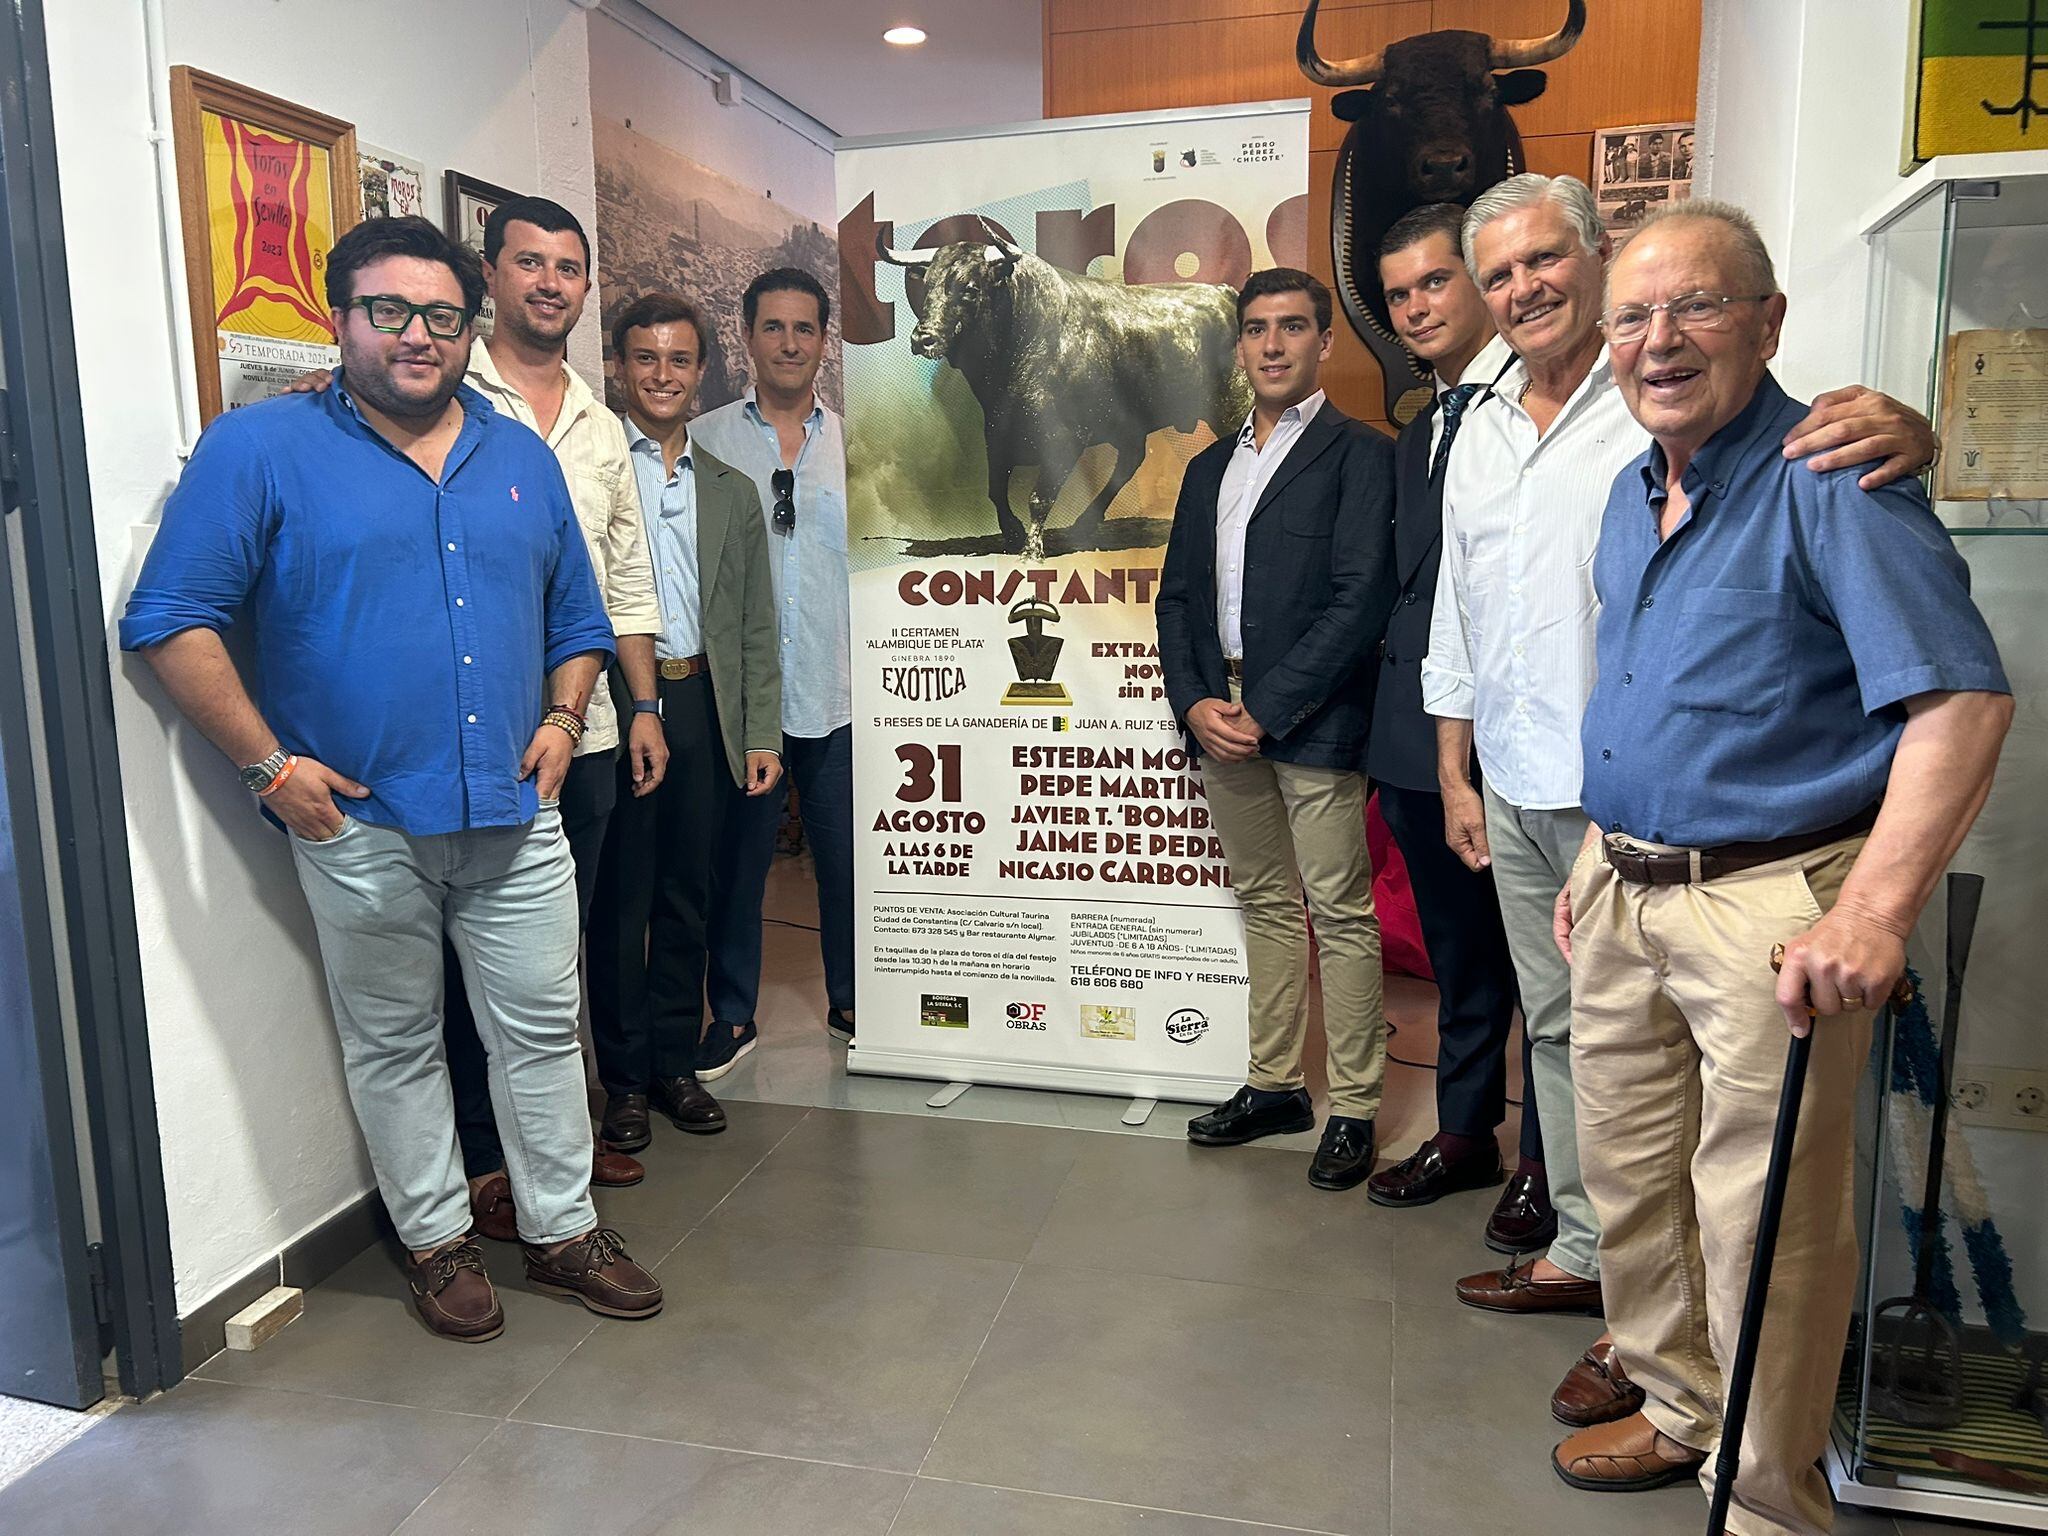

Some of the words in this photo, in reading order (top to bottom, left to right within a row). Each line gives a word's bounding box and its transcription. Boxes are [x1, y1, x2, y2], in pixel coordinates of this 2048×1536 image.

[1242, 141, 1275, 149] PEDRO
[1243, 147, 1274, 155] PÉREZ
[247, 140, 288, 178] Toros
[264, 183, 277, 196] en
[254, 197, 289, 227] Sevilla
[262, 241, 282, 256] 2023
[837, 191, 1308, 345] tro
[245, 344, 305, 363] TEMPORADA
[308, 353, 326, 364] 2023
[240, 363, 262, 371] JUEVES
[243, 375, 276, 383] NOVILLADA
[898, 569, 1164, 606] CONSTANT
[901, 628, 959, 637] CERTAMEN
[934, 639, 947, 649] DE
[1091, 643, 1159, 657] EXTRA
[891, 654, 932, 662] GINEBRA
[934, 654, 955, 662] 1890
[1124, 664, 1163, 679] NOV
[882, 665, 967, 702] EXÓTICA
[1118, 682, 1144, 698] sin
[874, 717, 881, 728] 5
[884, 718, 924, 728] RESES
[927, 718, 943, 728] DE
[945, 718, 960, 729] LA
[962, 715, 1029, 729] GANADERÍA
[1032, 718, 1048, 729] DE
[1074, 719, 1107, 730] JUAN
[1111, 719, 1121, 730] A.
[1125, 720, 1153, 730] RUIZ
[1012, 745, 1135, 770] ESTEBAN
[895, 743, 962, 803] 31
[1021, 774, 1092, 797] PEPE
[1100, 775, 1207, 800] MARTÍN
[872, 809, 986, 834] AGOSTO
[1011, 805, 1090, 826] JAVIER
[1095, 807, 1113, 826] T.
[1117, 804, 1215, 829] 'BOMB
[883, 841, 896, 857] A
[900, 842, 930, 858] LAS
[933, 842, 946, 858] 6
[953, 844, 973, 859] DE
[1016, 830, 1097, 854] JAIME
[1106, 832, 1141, 855] DE
[1149, 834, 1225, 859] PEDR
[888, 860, 910, 876] LA
[913, 861, 970, 877] TARDE
[999, 859, 1094, 882] NICASIO
[873, 905, 905, 913] PUNTOS
[906, 906, 918, 914] DE
[919, 907, 945, 915] VENTA:
[947, 908, 988, 917] Asociación
[989, 910, 1019, 918] Cultural
[1021, 912, 1050, 920] Taurina
[1071, 913, 1109, 921] BARRERA
[1110, 914, 1156, 924] (numerada)
[913, 917, 958, 926] Constantina
[973, 920, 1005, 928] Calvario
[1071, 922, 1108, 930] ENTRADA
[1109, 924, 1147, 932] GENERAL
[1149, 925, 1163, 933] (sin
[1165, 928, 1202, 936] numerar)
[873, 926, 910, 934] Contacto:
[982, 931, 1026, 939] restaurante
[1070, 931, 1115, 939] JUBILADOS
[1070, 939, 1113, 948] JUVENTUD
[912, 957, 931, 965] 10.30
[1002, 962, 1030, 970] horario
[1029, 954, 1057, 963] festejo
[874, 966, 929, 975] ininterrumpido
[962, 971, 999, 979] comienzo
[1021, 974, 1057, 982] novillada.
[1070, 964, 1132, 977] TELÉFONO
[1135, 969, 1151, 979] DE
[1154, 970, 1182, 981] INFO
[1185, 972, 1194, 981] Y
[1197, 973, 1250, 985] RESERVA
[1071, 976, 1091, 986] 618
[1094, 978, 1117, 987] 606
[1120, 979, 1143, 989] 680
[1006, 1020, 1047, 1031] OBRAS
[1167, 1020, 1209, 1035] Sierra
